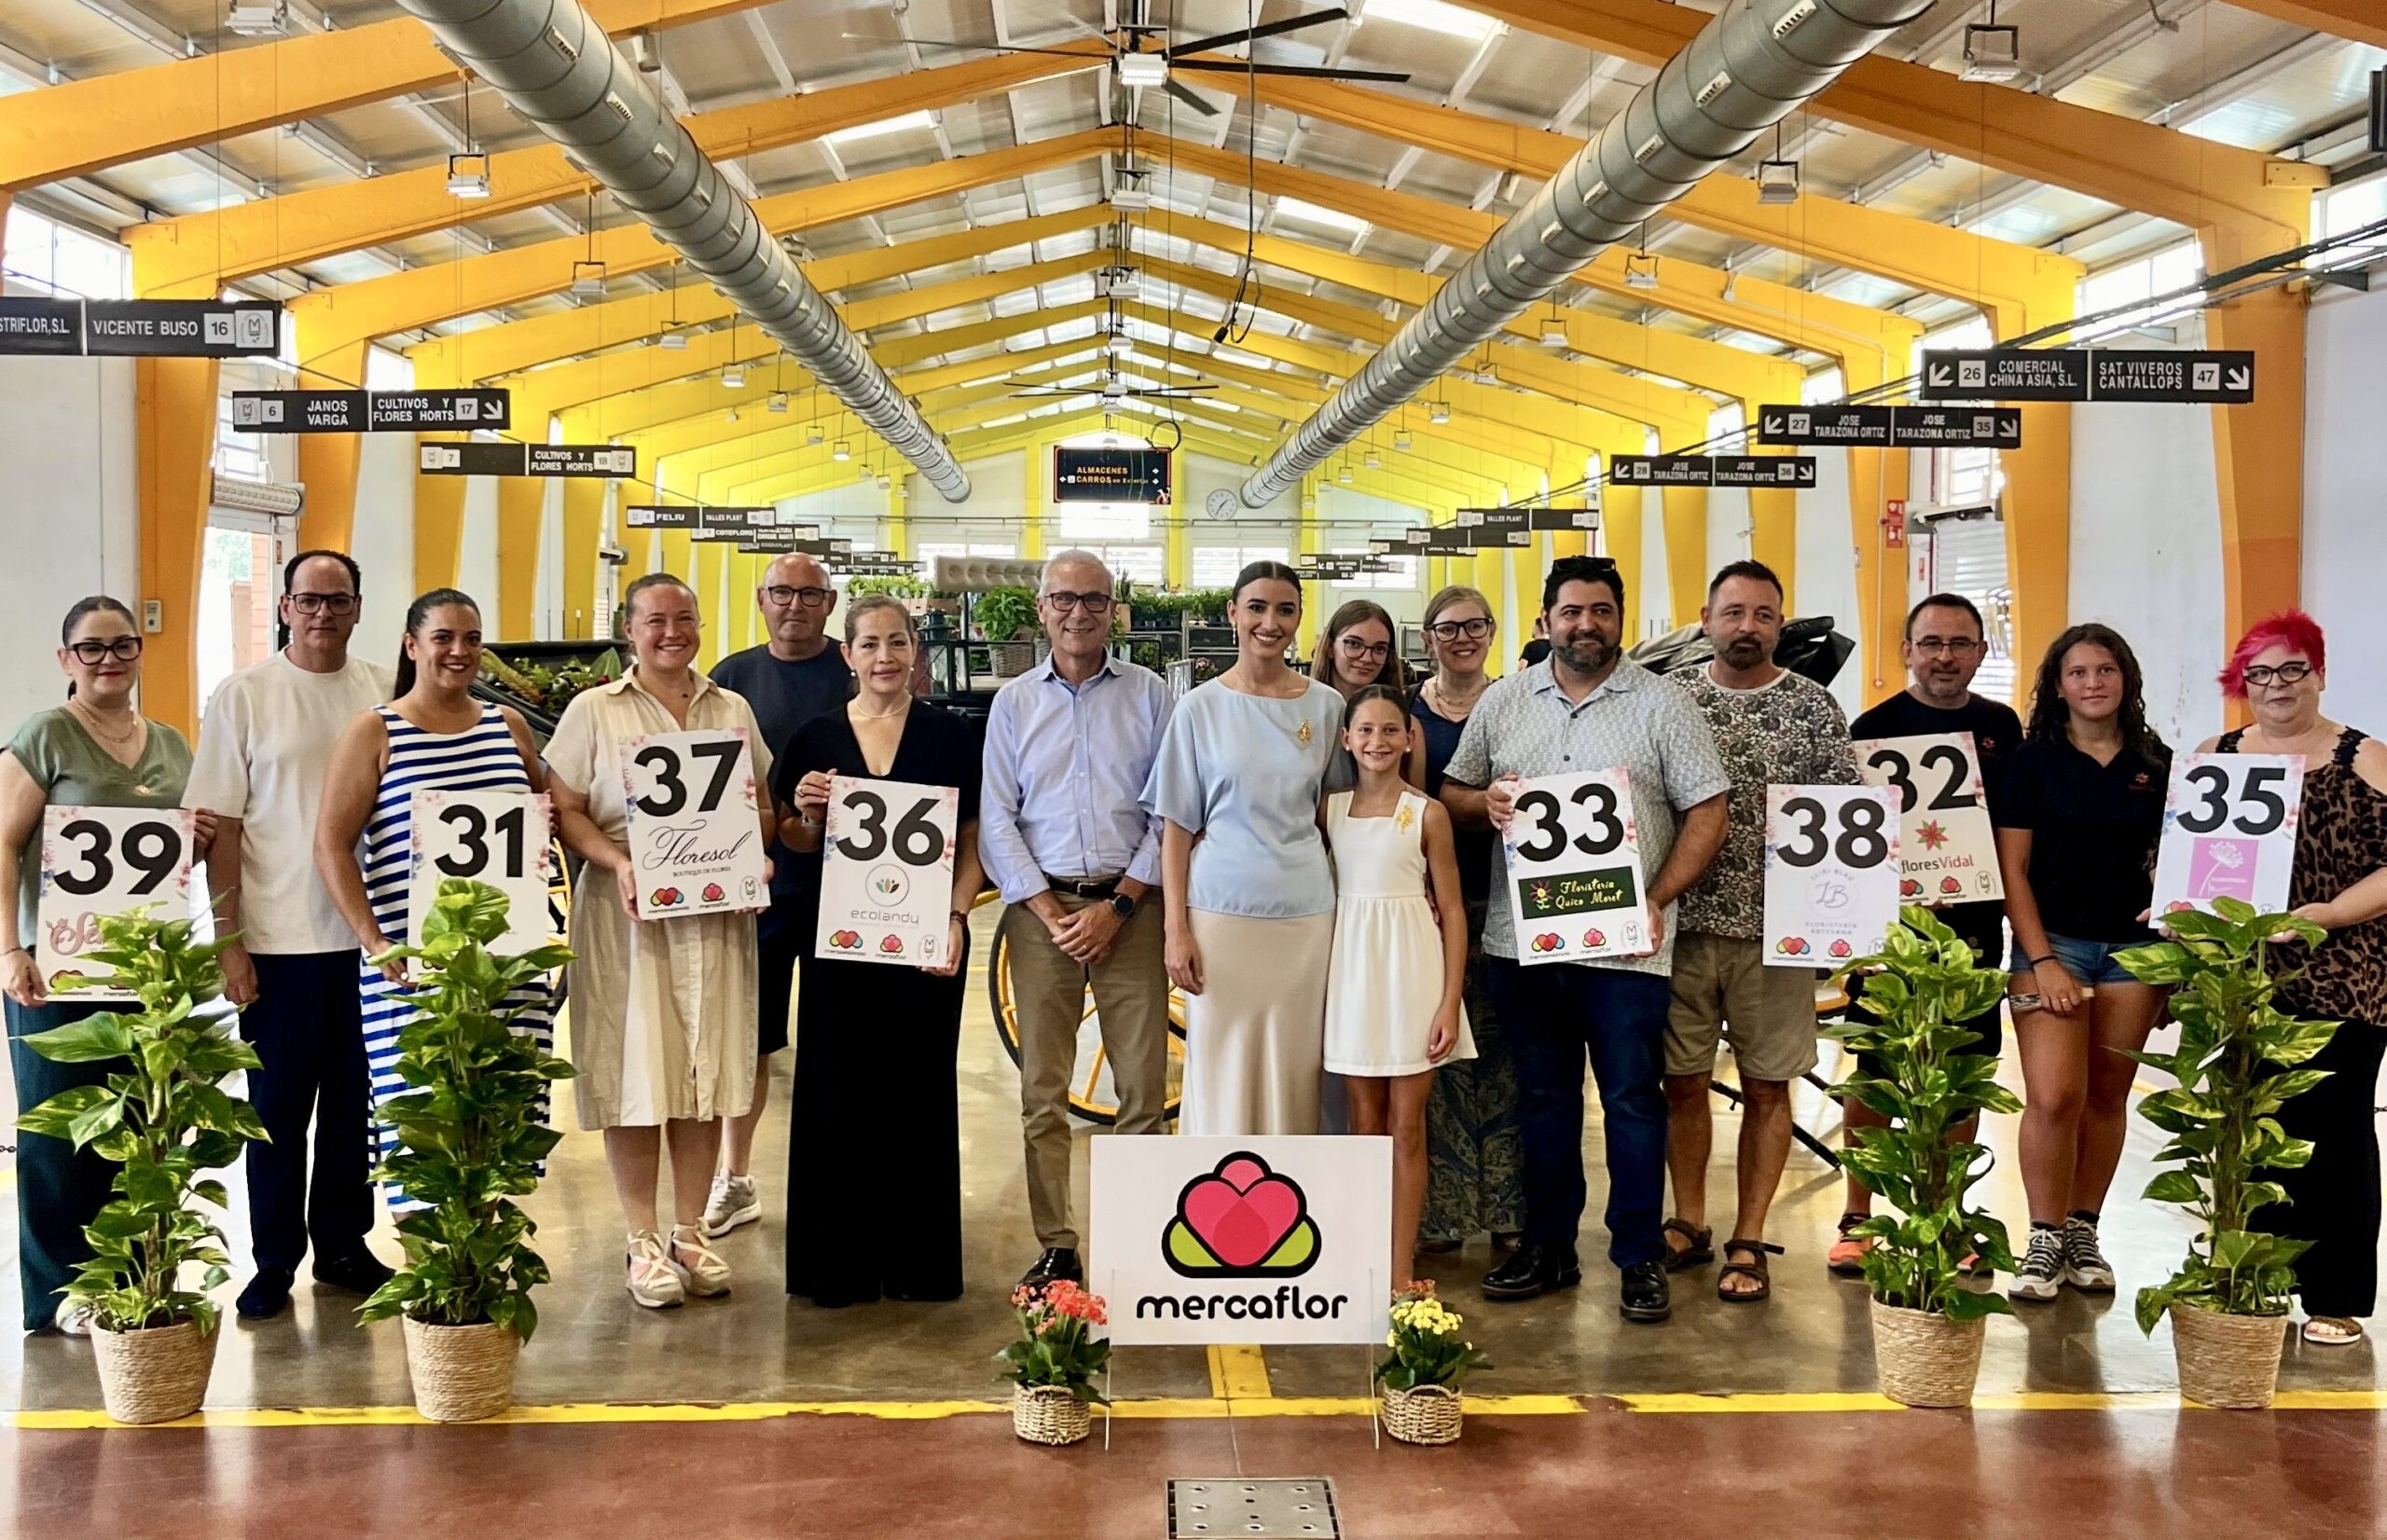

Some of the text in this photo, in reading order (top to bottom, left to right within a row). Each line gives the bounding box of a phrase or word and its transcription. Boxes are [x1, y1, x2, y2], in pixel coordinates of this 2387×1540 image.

[93, 321, 199, 336] VICENTE BUSO
[211, 322, 228, 336] 16
[1998, 360, 2065, 373] COMERCIAL
[2099, 362, 2183, 375] SAT VIVEROS
[1963, 367, 1981, 380] 26
[2197, 370, 2215, 383] 47
[1989, 373, 2077, 389] CHINA ASIA, S.L.
[2099, 376, 2183, 390] CANTALLOPS
[307, 400, 349, 412] JANOS
[378, 398, 449, 410] CULTIVOS Y
[461, 405, 473, 415] 17
[269, 406, 276, 417] 6
[373, 410, 455, 422] FLORES HORTS
[308, 414, 349, 426] VARGA
[1792, 419, 1806, 430] 27
[1838, 415, 1860, 426] JOSE
[1923, 414, 1945, 425] JOSE
[1814, 426, 1885, 438] TARAZONA ORTIZ
[1977, 421, 1991, 432] 35
[1897, 428, 1971, 440] TARAZONA ORTIZ
[535, 451, 572, 461] CULTIVOS
[531, 462, 593, 472] FLORES HORTS
[1635, 466, 1648, 475] 28
[1671, 462, 1690, 471] JOSE
[1736, 462, 1755, 471] JOSE
[1781, 468, 1792, 476] 36
[1076, 475, 1111, 484] CARROS
[1653, 471, 1708, 481] TARAZONA ORTIZ
[1716, 472, 1775, 481] TARAZONA ORTIZ
[656, 514, 685, 522] FELIU
[634, 740, 744, 818] 37
[1867, 745, 1978, 814] 32
[2176, 764, 2286, 835] 35
[835, 791, 945, 866] 36
[1514, 783, 1624, 862] 33
[1775, 796, 1888, 869] 38
[435, 804, 524, 878] 31
[53, 819, 182, 895] 39
[1555, 889, 1624, 910] Quico Moret
[850, 910, 919, 925] ecolandy
[1136, 1286, 1348, 1320] mercaflor
